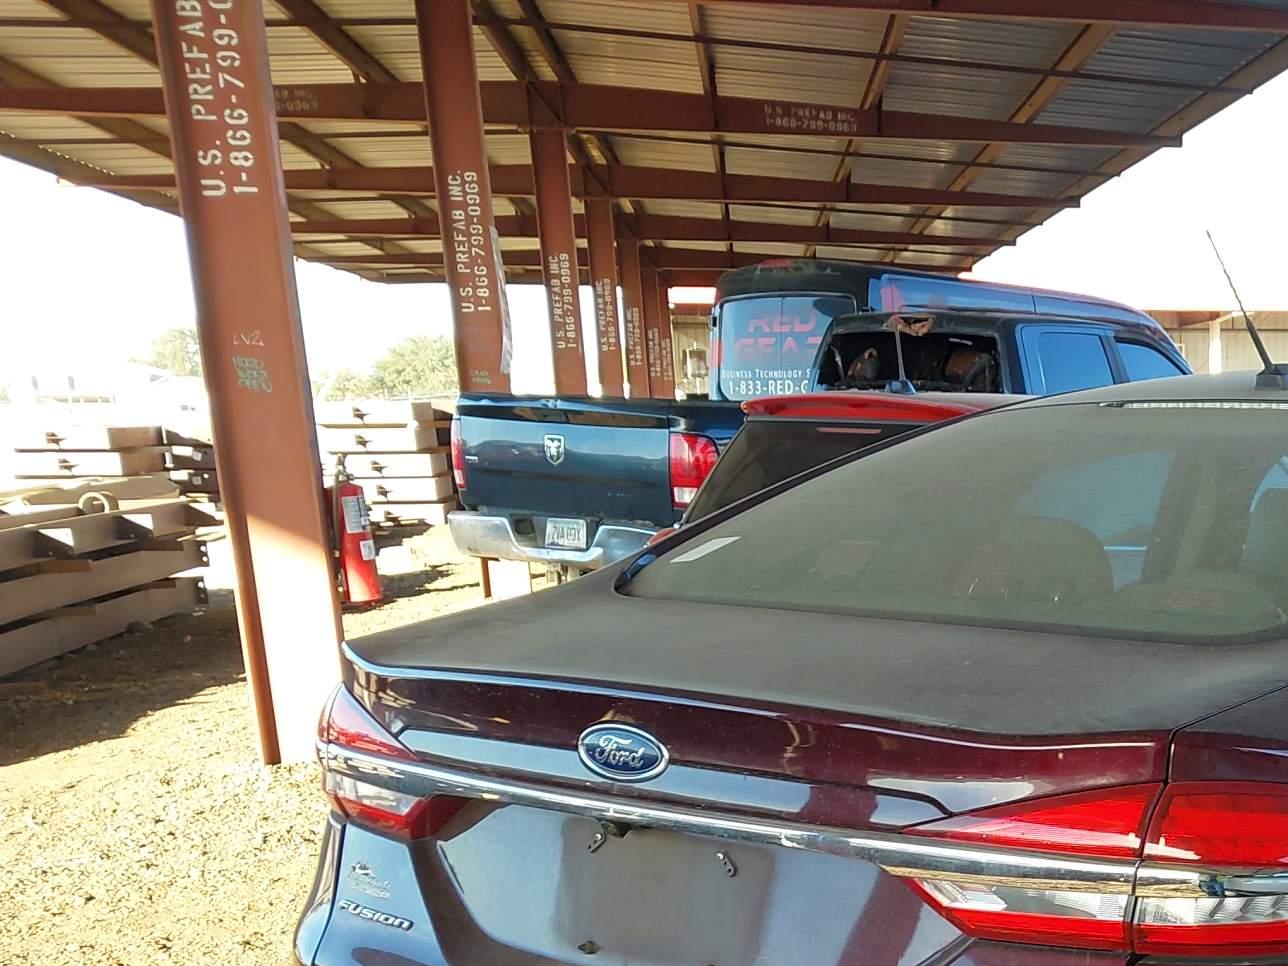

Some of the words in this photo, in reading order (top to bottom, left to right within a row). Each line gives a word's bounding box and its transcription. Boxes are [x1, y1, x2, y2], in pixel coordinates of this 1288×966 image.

[175, 0, 218, 121] PREFAB
[197, 139, 227, 197] U.S.
[448, 169, 463, 201] INC.
[452, 209, 471, 273] PREFAB
[464, 171, 491, 311] 1-866-799-0969
[460, 282, 475, 312] U.S.
[550, 279, 564, 323] PREFAB
[560, 253, 577, 348] 1-866-799-0969
[755, 368, 803, 379] TECHNOLOGY
[594, 734, 646, 768] Ford
